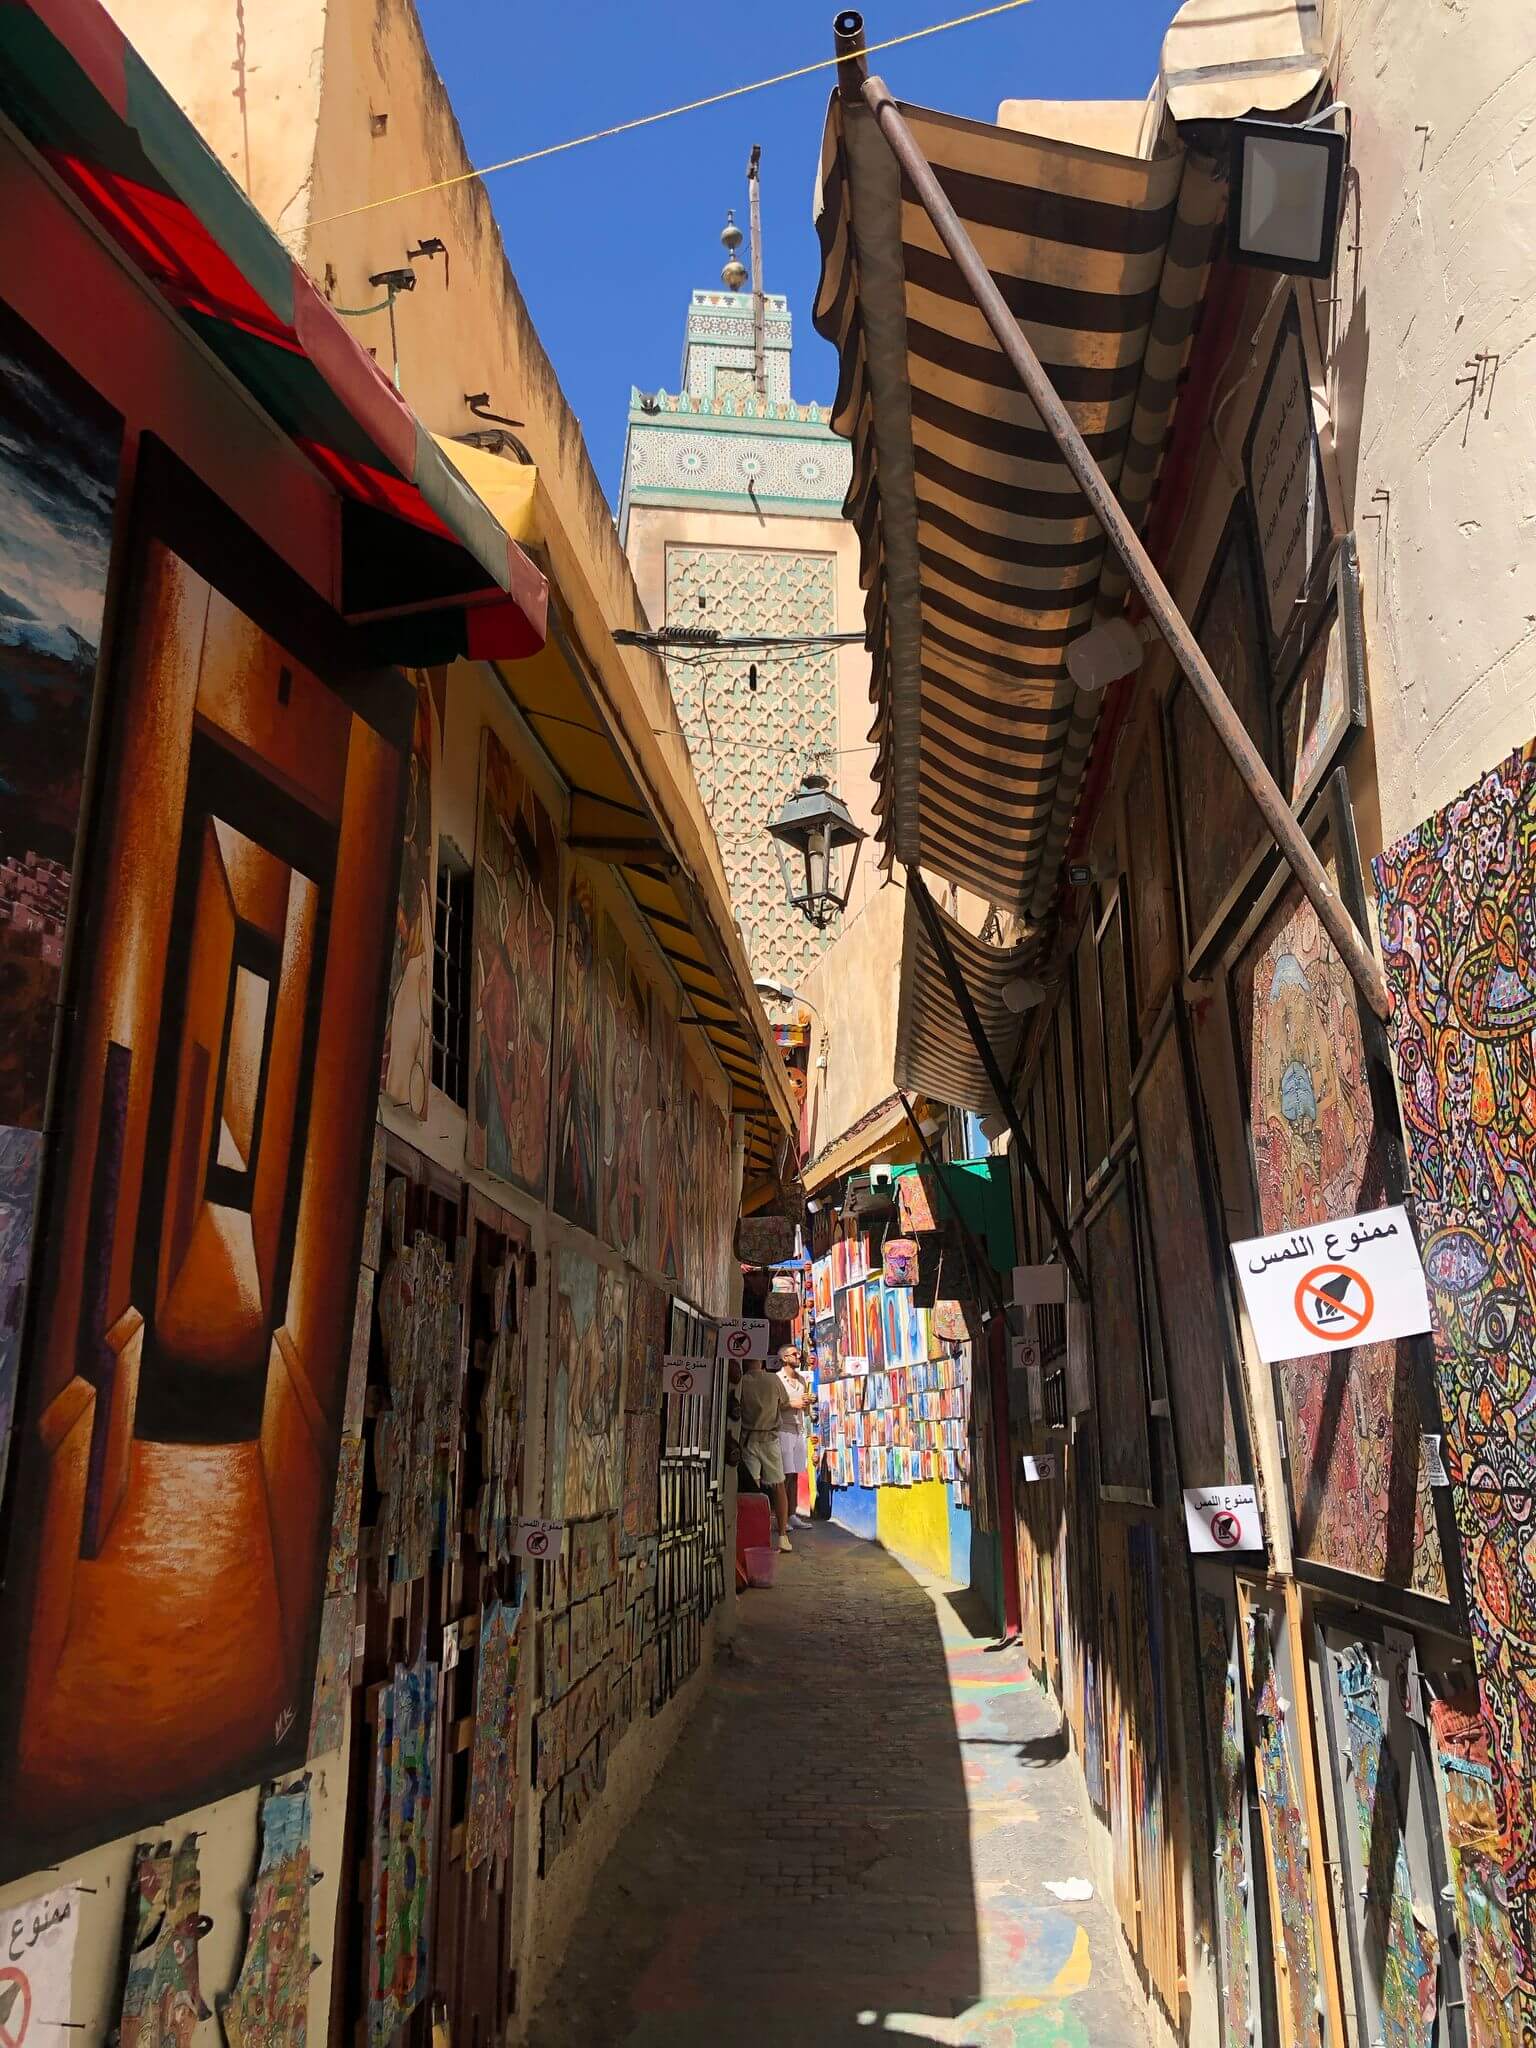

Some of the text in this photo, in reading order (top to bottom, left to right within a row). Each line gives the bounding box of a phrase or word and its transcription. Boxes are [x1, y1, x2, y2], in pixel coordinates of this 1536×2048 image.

[1248, 1221, 1399, 1274] ممنوع اللمس
[1194, 1495, 1253, 1510] ممنوع اللمس
[9, 1900, 71, 1961] ممنوع
